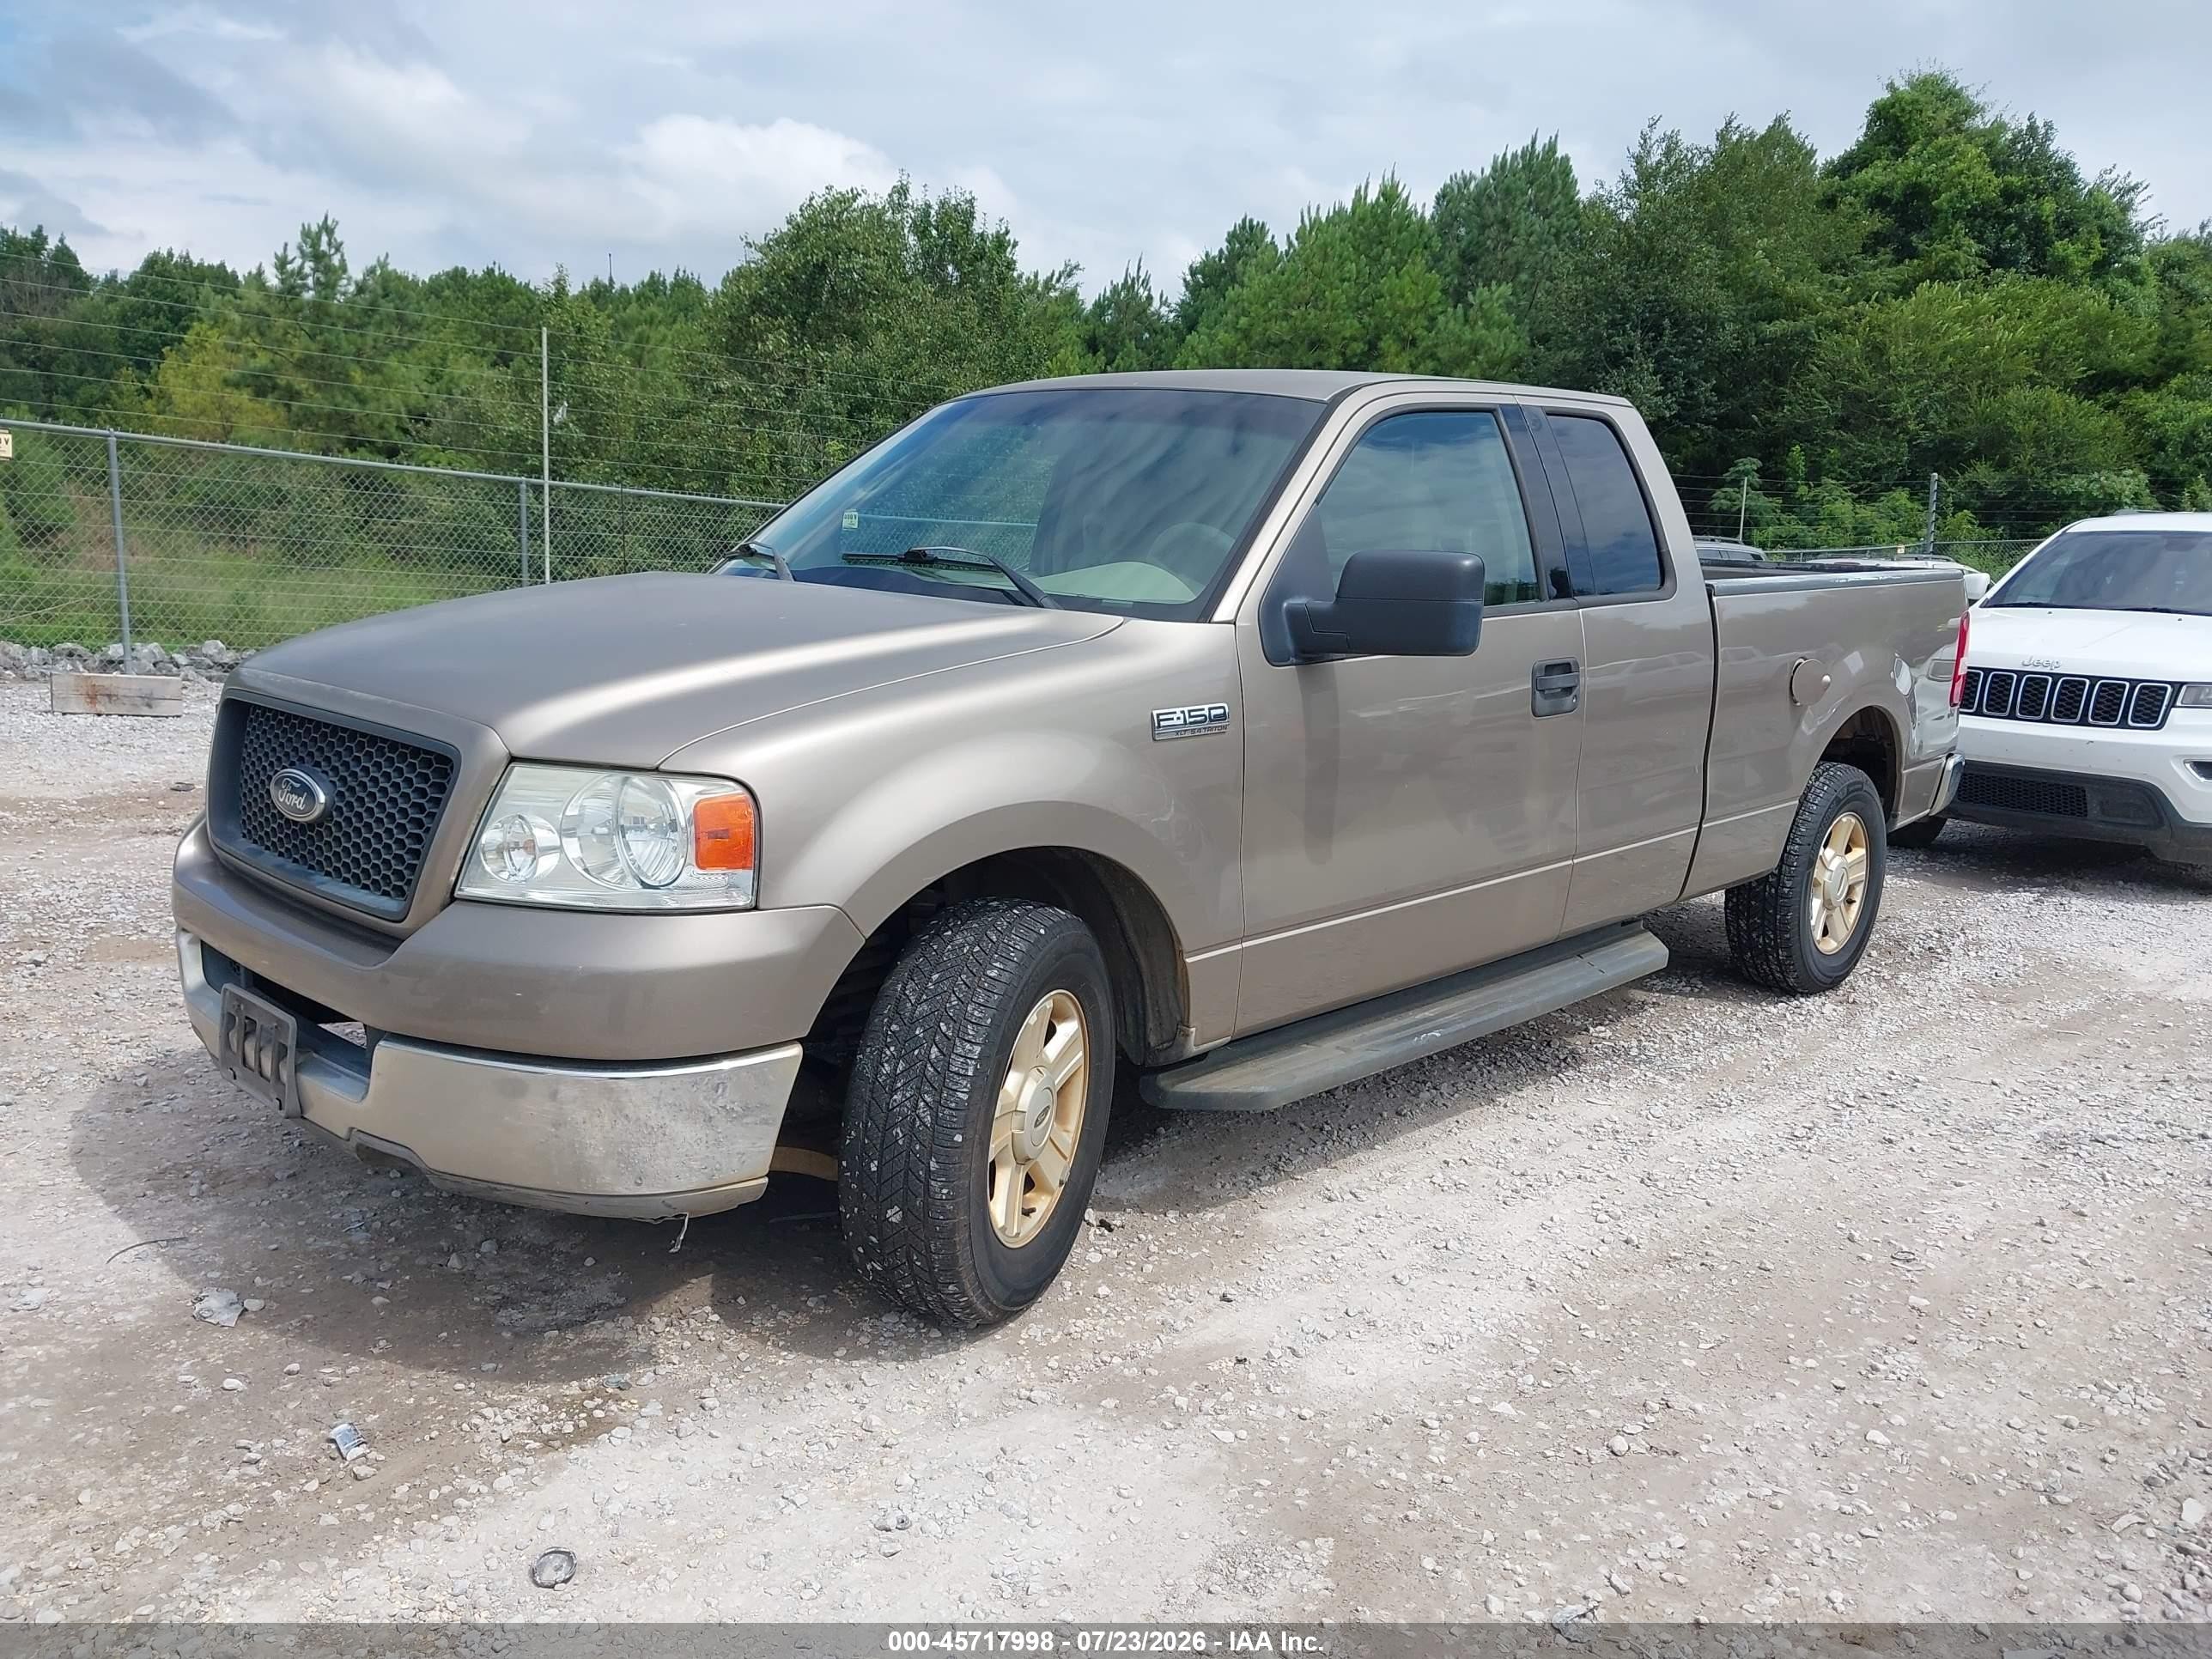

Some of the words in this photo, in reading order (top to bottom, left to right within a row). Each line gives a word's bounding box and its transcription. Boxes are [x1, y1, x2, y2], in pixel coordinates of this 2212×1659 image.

[2021, 655, 2062, 671] Jeep
[1155, 705, 1228, 729] F-150
[278, 777, 307, 810] Ford
